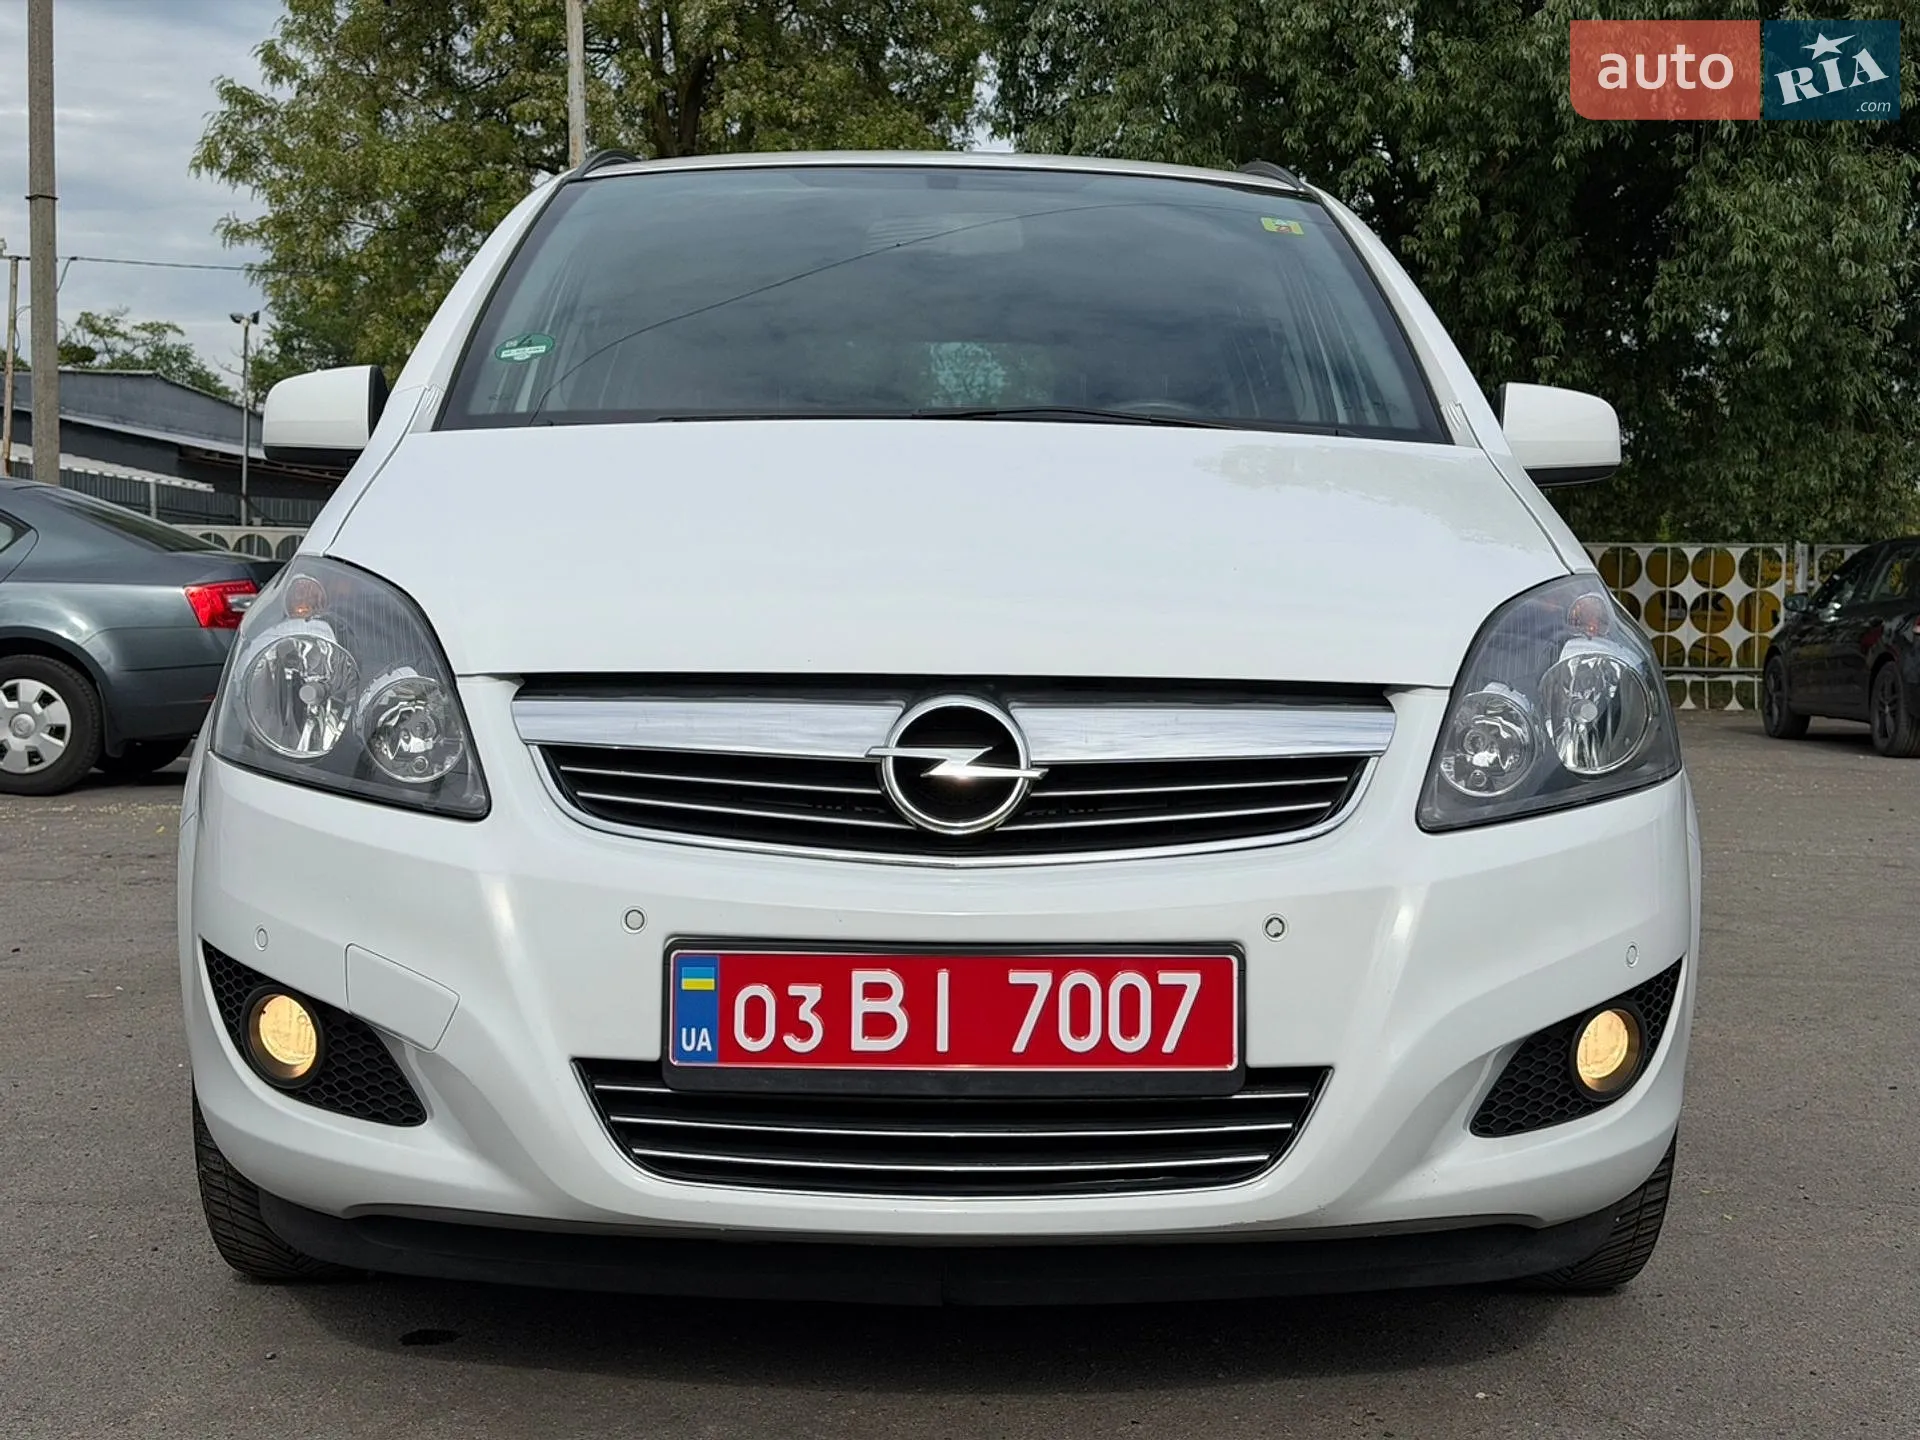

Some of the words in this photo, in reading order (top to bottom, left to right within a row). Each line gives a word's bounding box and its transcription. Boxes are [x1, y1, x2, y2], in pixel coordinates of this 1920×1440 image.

[733, 983, 824, 1053] 03
[1008, 969, 1202, 1053] 7007
[681, 1027, 713, 1052] UA
